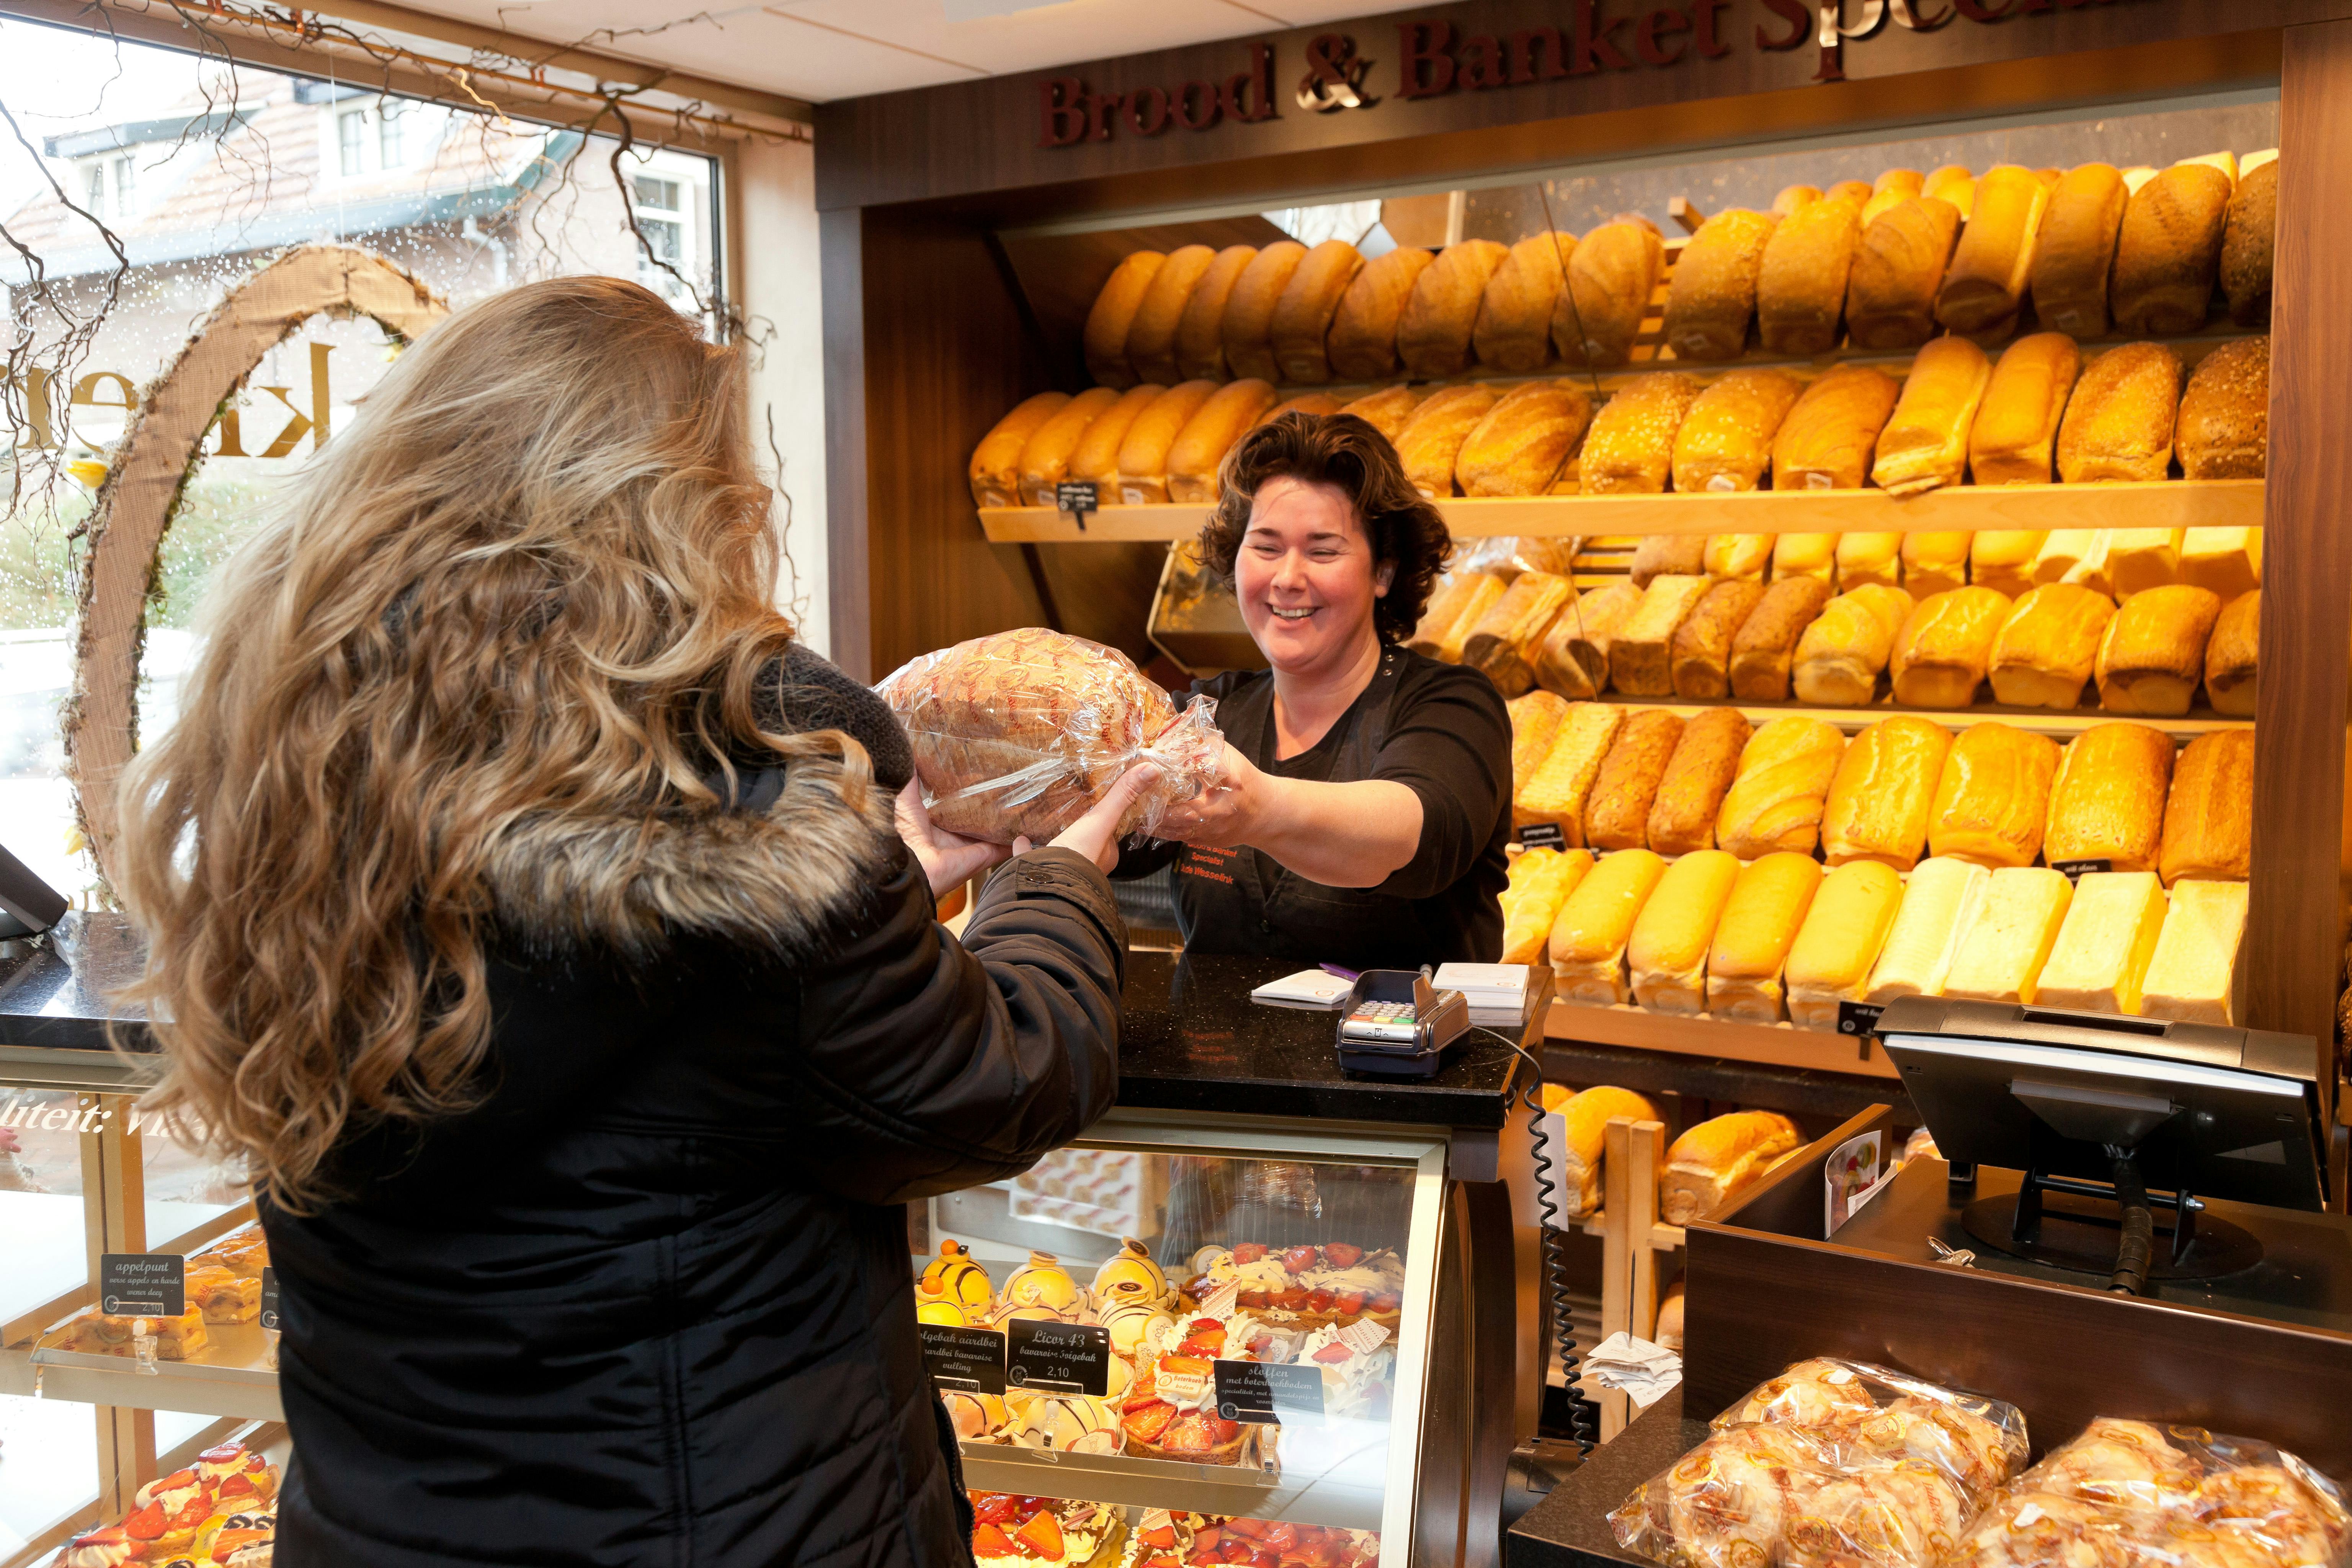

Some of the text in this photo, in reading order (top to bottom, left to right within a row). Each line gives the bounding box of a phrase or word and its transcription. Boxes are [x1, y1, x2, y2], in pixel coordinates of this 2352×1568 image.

[1037, 40, 1277, 149] Brood
[1295, 32, 1372, 112] &
[1395, 0, 1730, 100] Banket
[1191, 852, 1224, 866] Specialist
[1194, 866, 1234, 885] Wesselink
[116, 1259, 170, 1275] appelpunt
[127, 1276, 150, 1285] appels
[160, 1276, 181, 1285] harde
[148, 1288, 163, 1298] deeg
[142, 1304, 161, 1312] 2,10
[1032, 1330, 1085, 1347] Licor 43
[954, 1349, 993, 1362] bavaroise
[1020, 1346, 1058, 1358] bavaroise
[943, 1362, 972, 1374] vulling
[1047, 1366, 1069, 1378] 2,10
[1248, 1365, 1289, 1379] sloffen
[1244, 1377, 1313, 1390] boterkoekbodem
